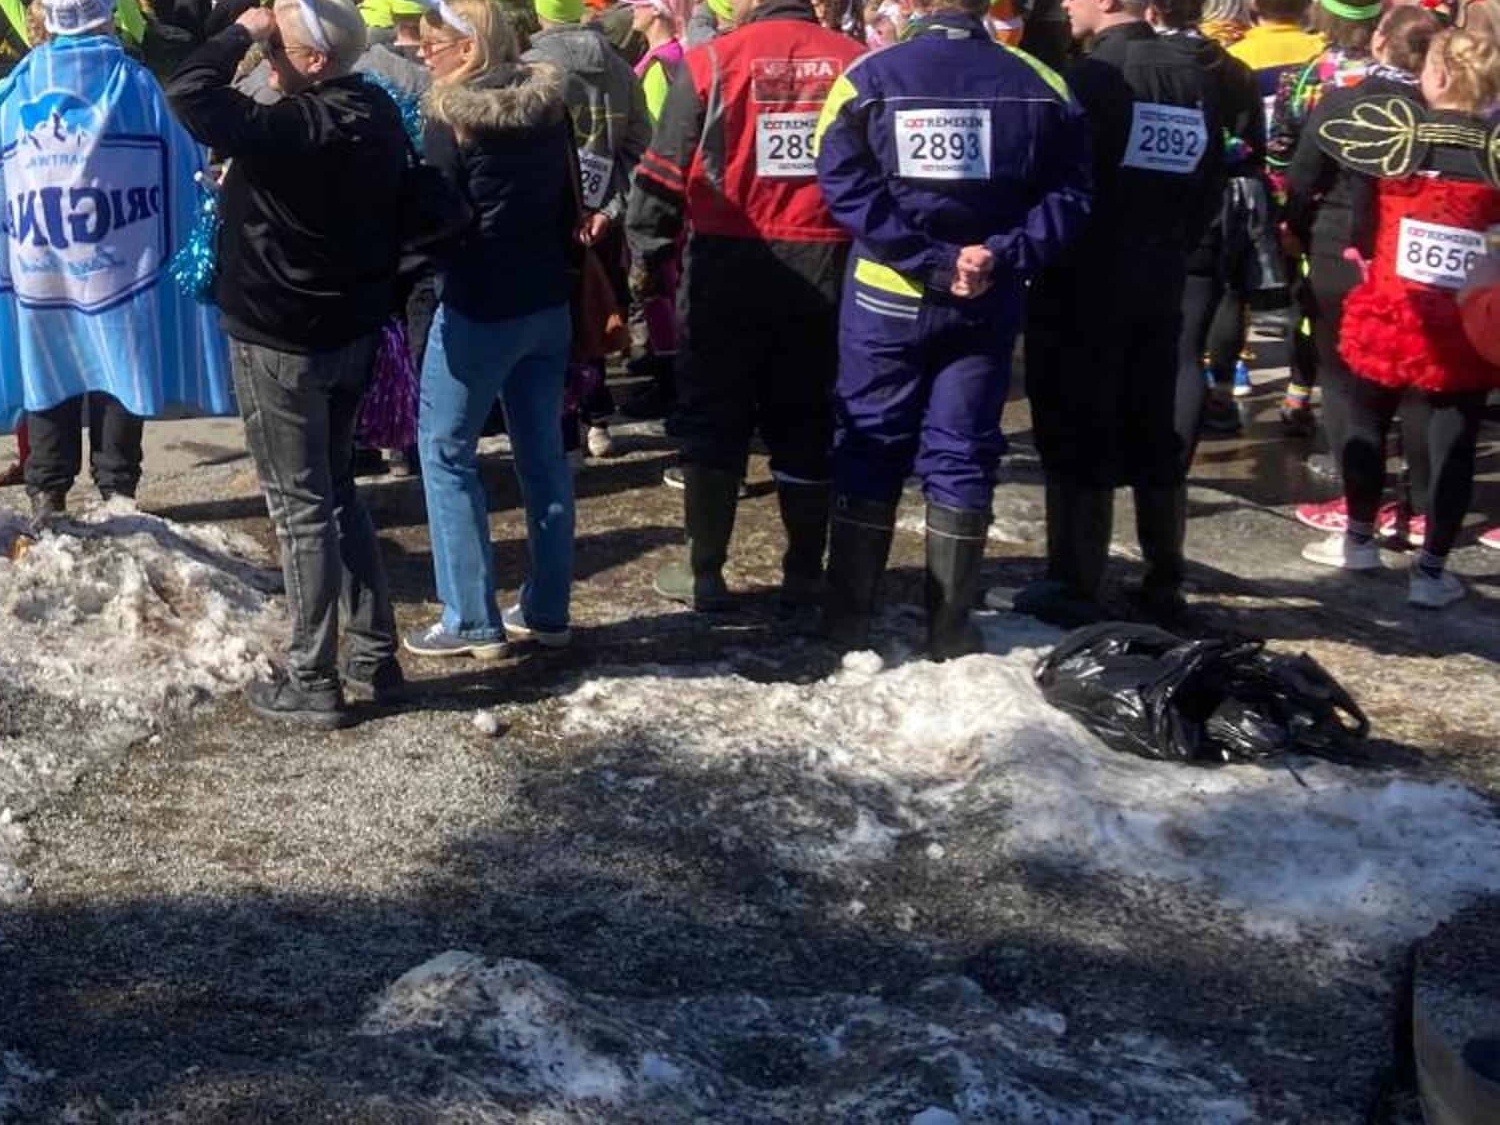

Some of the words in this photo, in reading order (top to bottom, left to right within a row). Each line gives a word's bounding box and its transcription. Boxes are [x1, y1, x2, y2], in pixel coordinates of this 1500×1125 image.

[768, 134, 815, 159] 289
[909, 132, 980, 160] 2893
[1139, 125, 1199, 157] 2892
